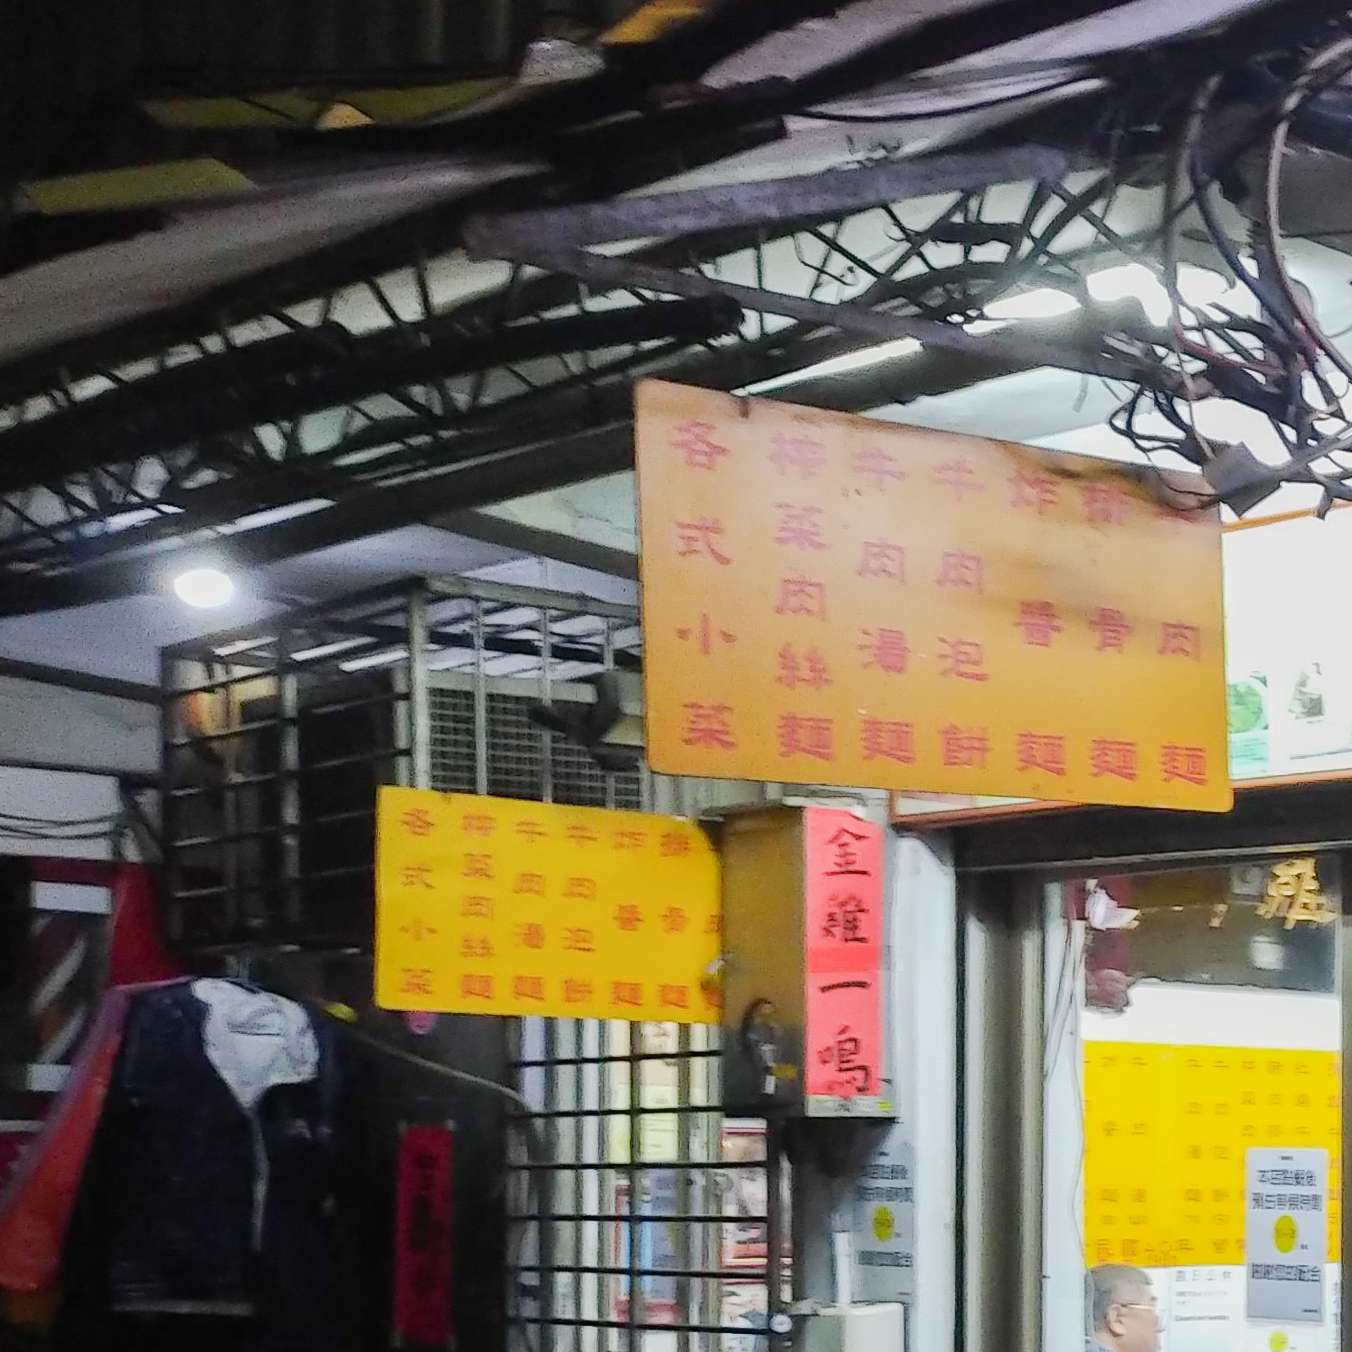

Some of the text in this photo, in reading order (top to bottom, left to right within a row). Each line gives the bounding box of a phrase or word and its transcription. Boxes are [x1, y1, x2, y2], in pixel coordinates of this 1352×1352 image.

[671, 420, 737, 751] 各式小菜
[851, 447, 917, 764] 牛肉湯麵
[399, 808, 438, 995] 各式小菜
